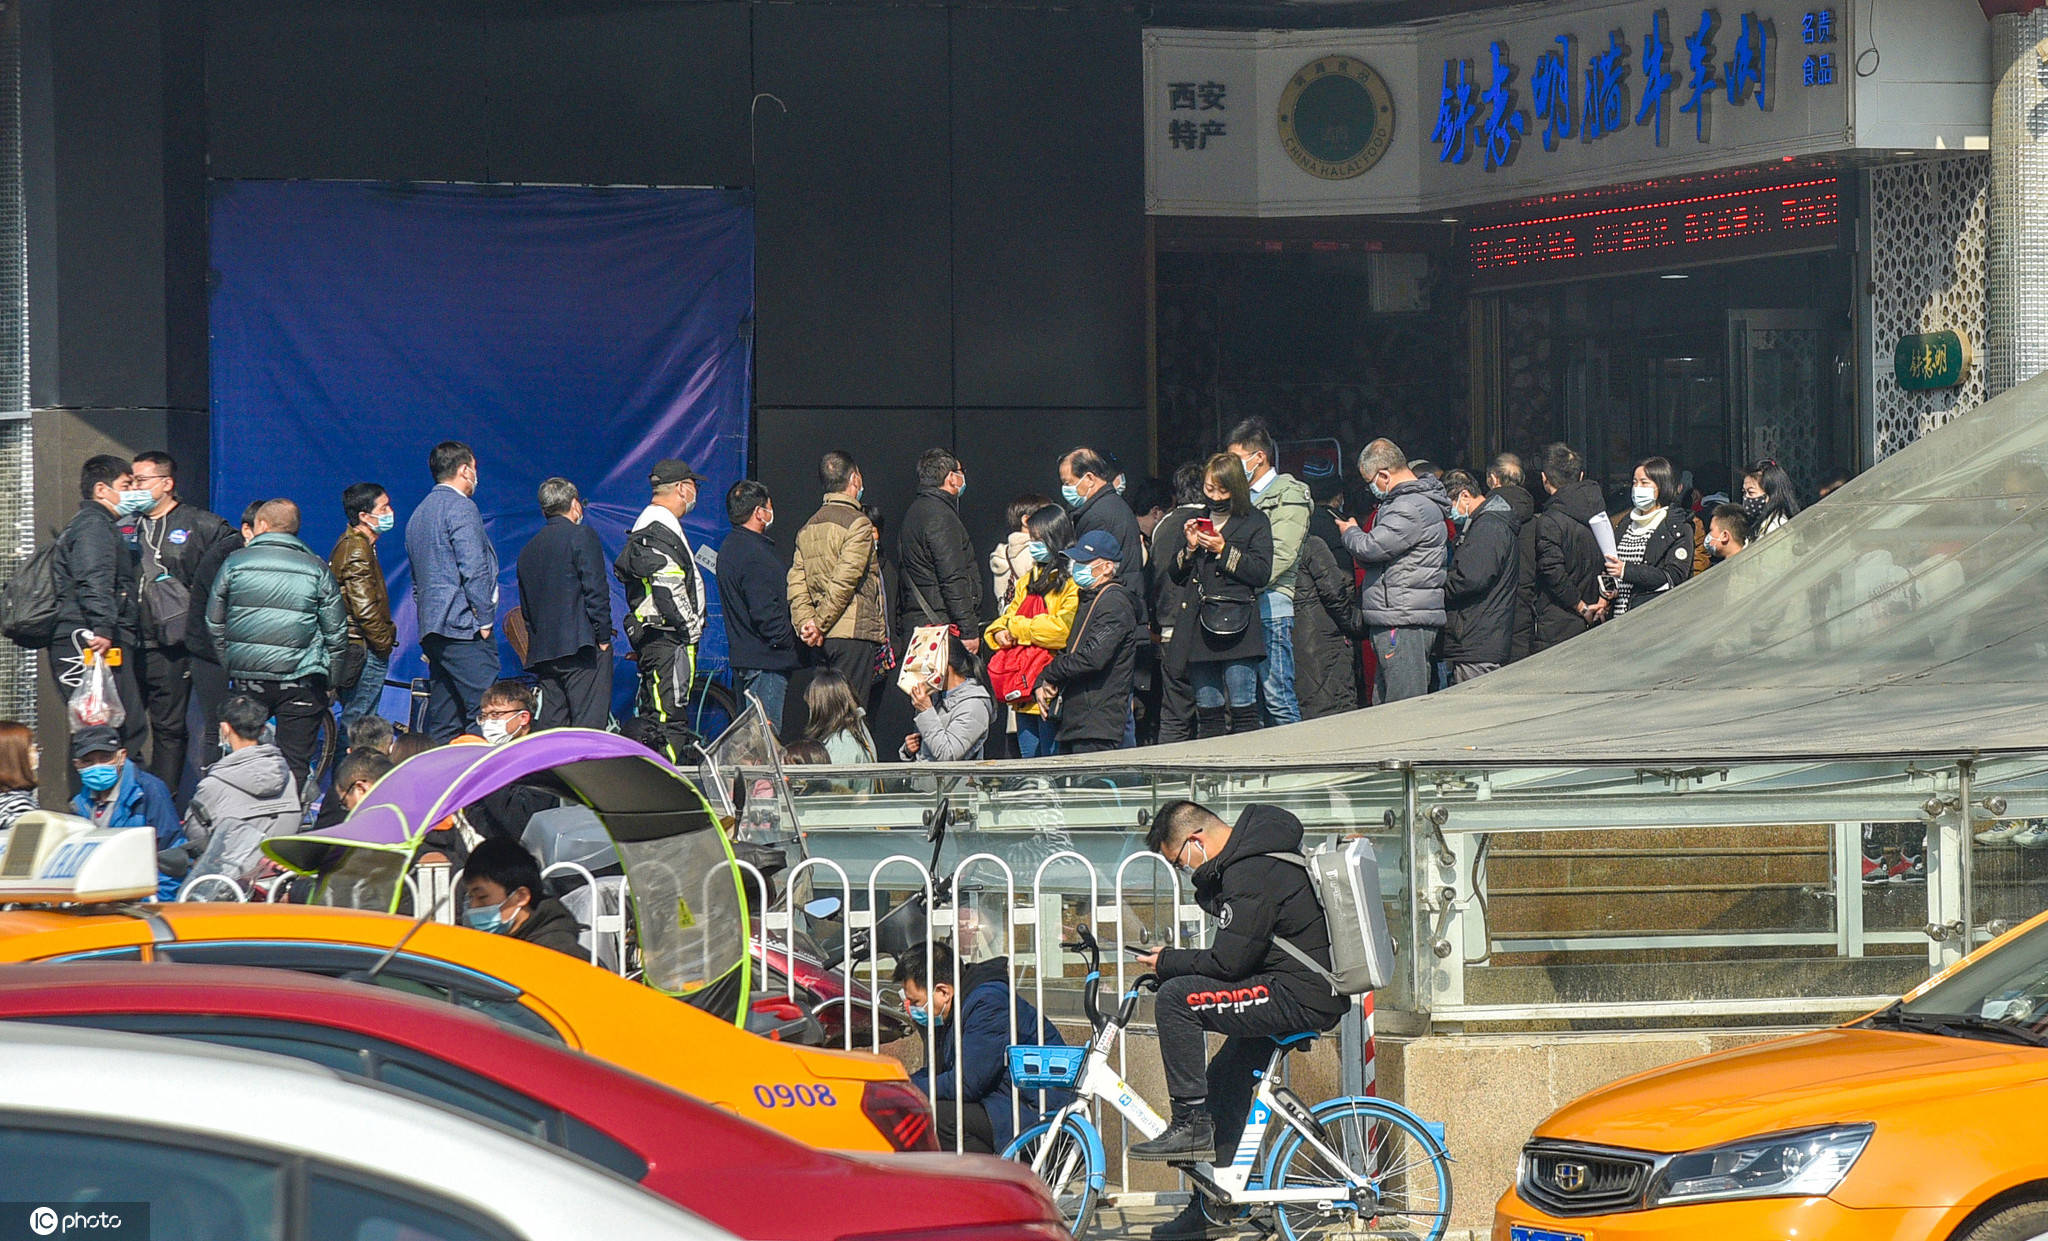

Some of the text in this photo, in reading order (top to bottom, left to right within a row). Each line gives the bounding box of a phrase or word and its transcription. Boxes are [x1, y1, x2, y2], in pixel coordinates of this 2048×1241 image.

[1801, 12, 1832, 44] 名贵
[1802, 55, 1832, 86] 食品
[1168, 81, 1226, 111] 西安
[1168, 120, 1227, 150] 特产
[1285, 127, 1386, 176] CHINA HALAL FOOD
[1187, 985, 1270, 1014] adidas
[753, 1084, 837, 1108] 0908
[1254, 1109, 1267, 1125] P
